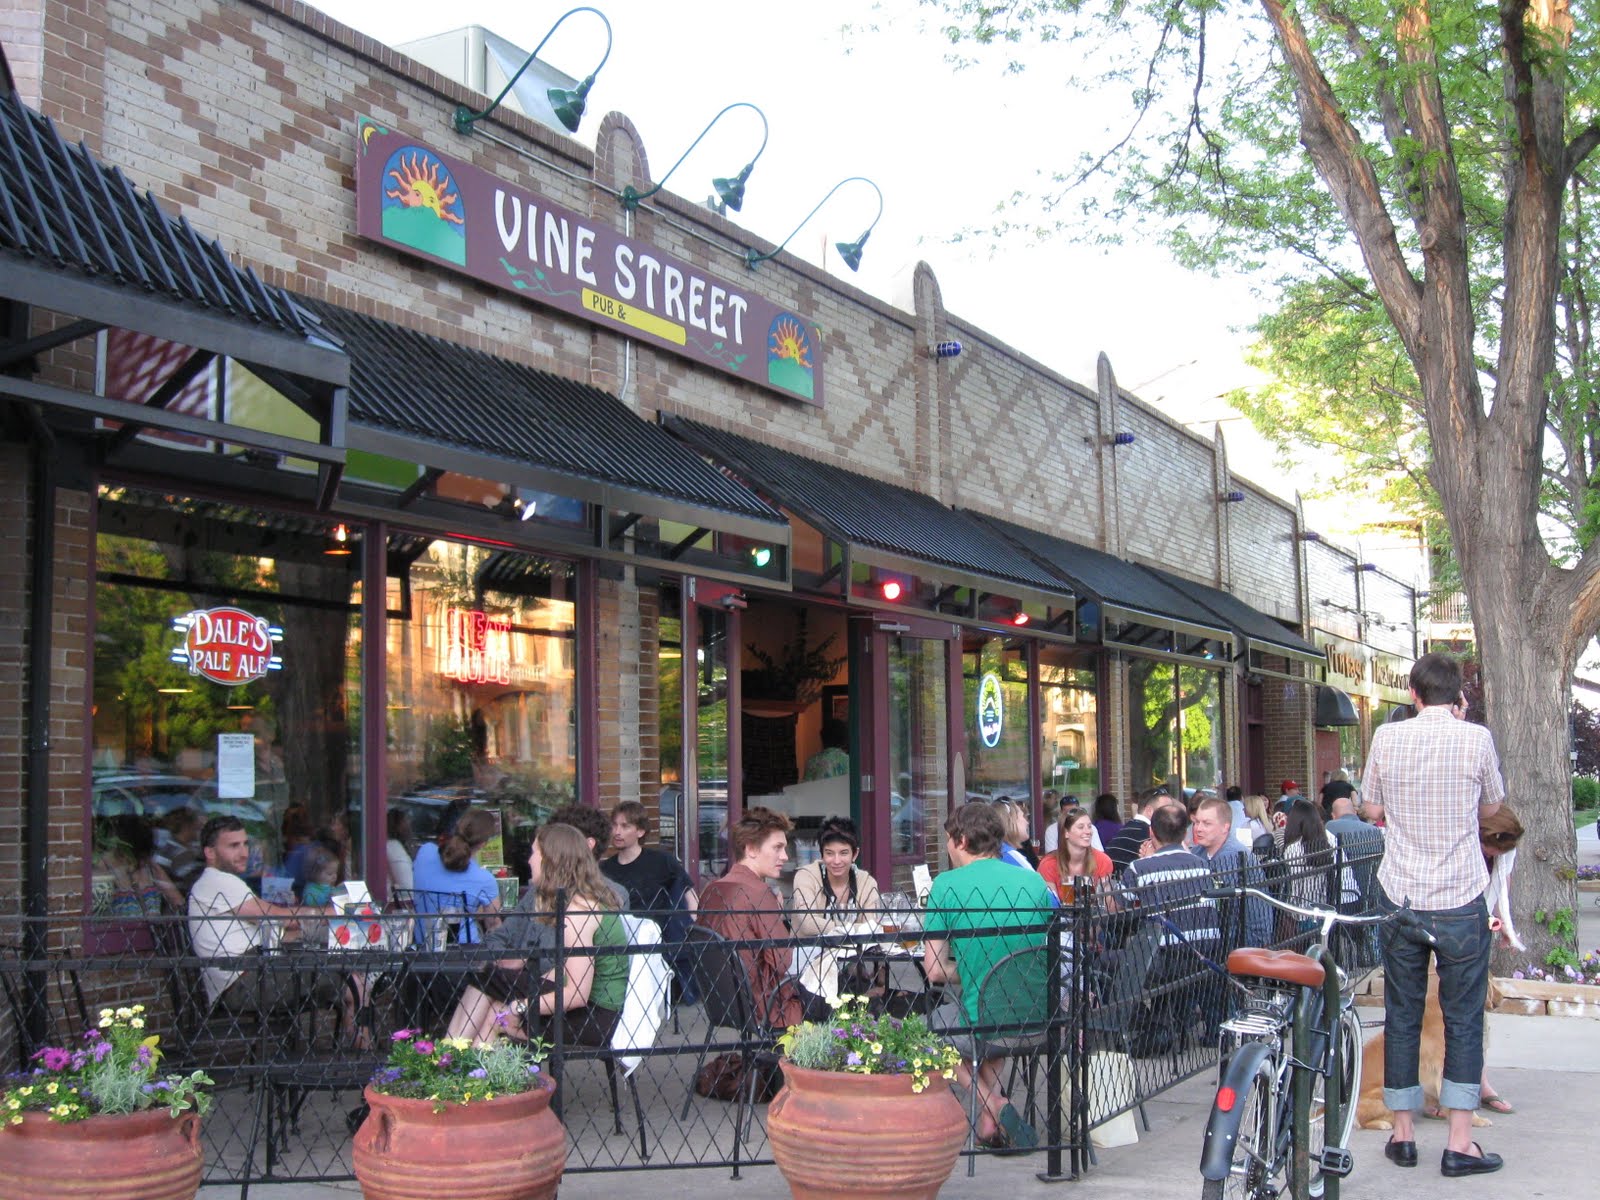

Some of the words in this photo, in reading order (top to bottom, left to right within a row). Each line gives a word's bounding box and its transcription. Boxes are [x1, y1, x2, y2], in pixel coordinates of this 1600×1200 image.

[495, 189, 597, 286] VINE
[614, 244, 748, 345] STREET
[592, 293, 615, 315] PUB
[617, 304, 627, 321] &
[195, 612, 268, 652] DALE'S
[192, 649, 231, 675] PALE
[236, 654, 266, 678] ALE
[1325, 643, 1366, 686] Vintage
